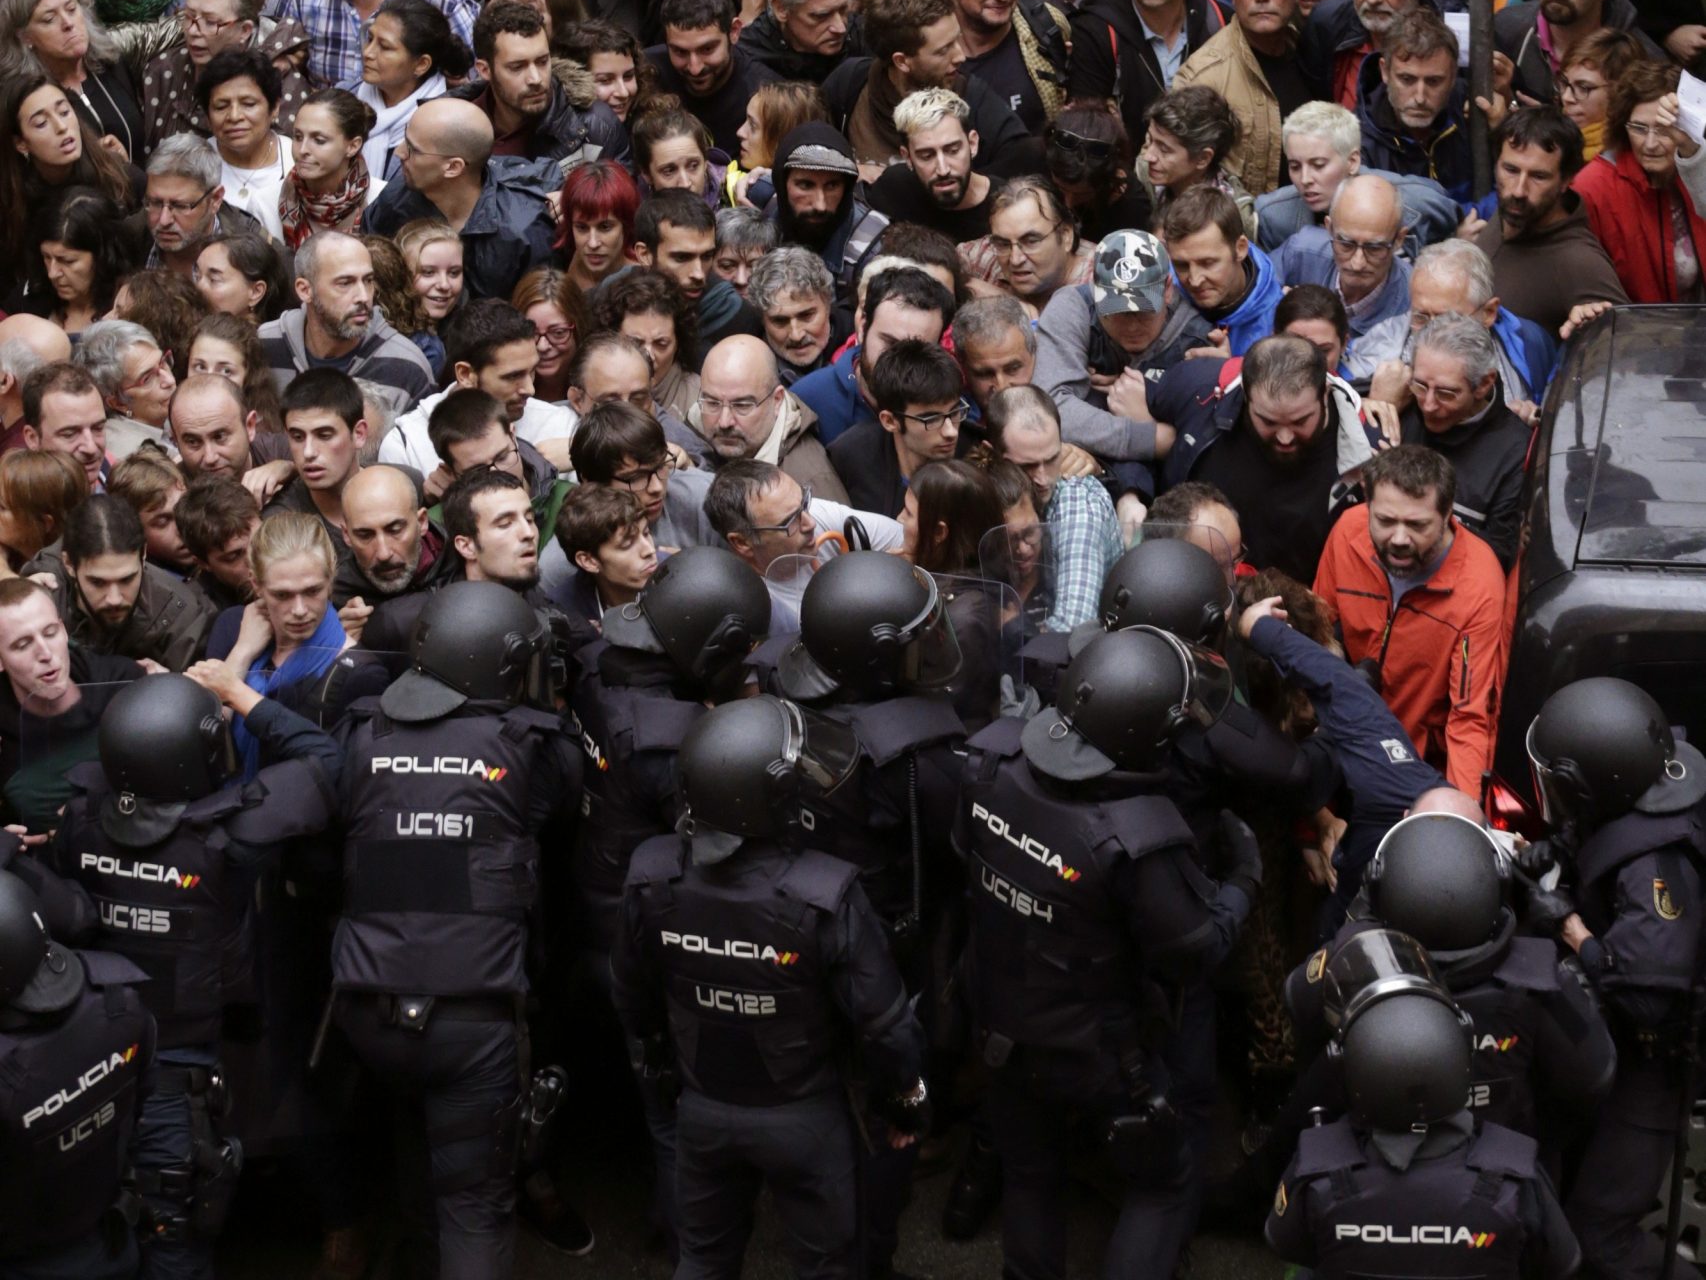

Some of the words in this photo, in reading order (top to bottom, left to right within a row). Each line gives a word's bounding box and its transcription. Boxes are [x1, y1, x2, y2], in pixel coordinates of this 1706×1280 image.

[371, 756, 487, 775] POLICIA
[396, 812, 474, 839] UC161
[972, 802, 1063, 874] POLICIA
[81, 852, 182, 884] POLICIA
[982, 865, 1053, 923] UC164
[100, 901, 171, 933] UC125
[661, 930, 780, 960] POLICIA
[695, 985, 776, 1014] UC122
[22, 1052, 125, 1128] POLICIA
[1335, 1224, 1475, 1245] POLICIA
